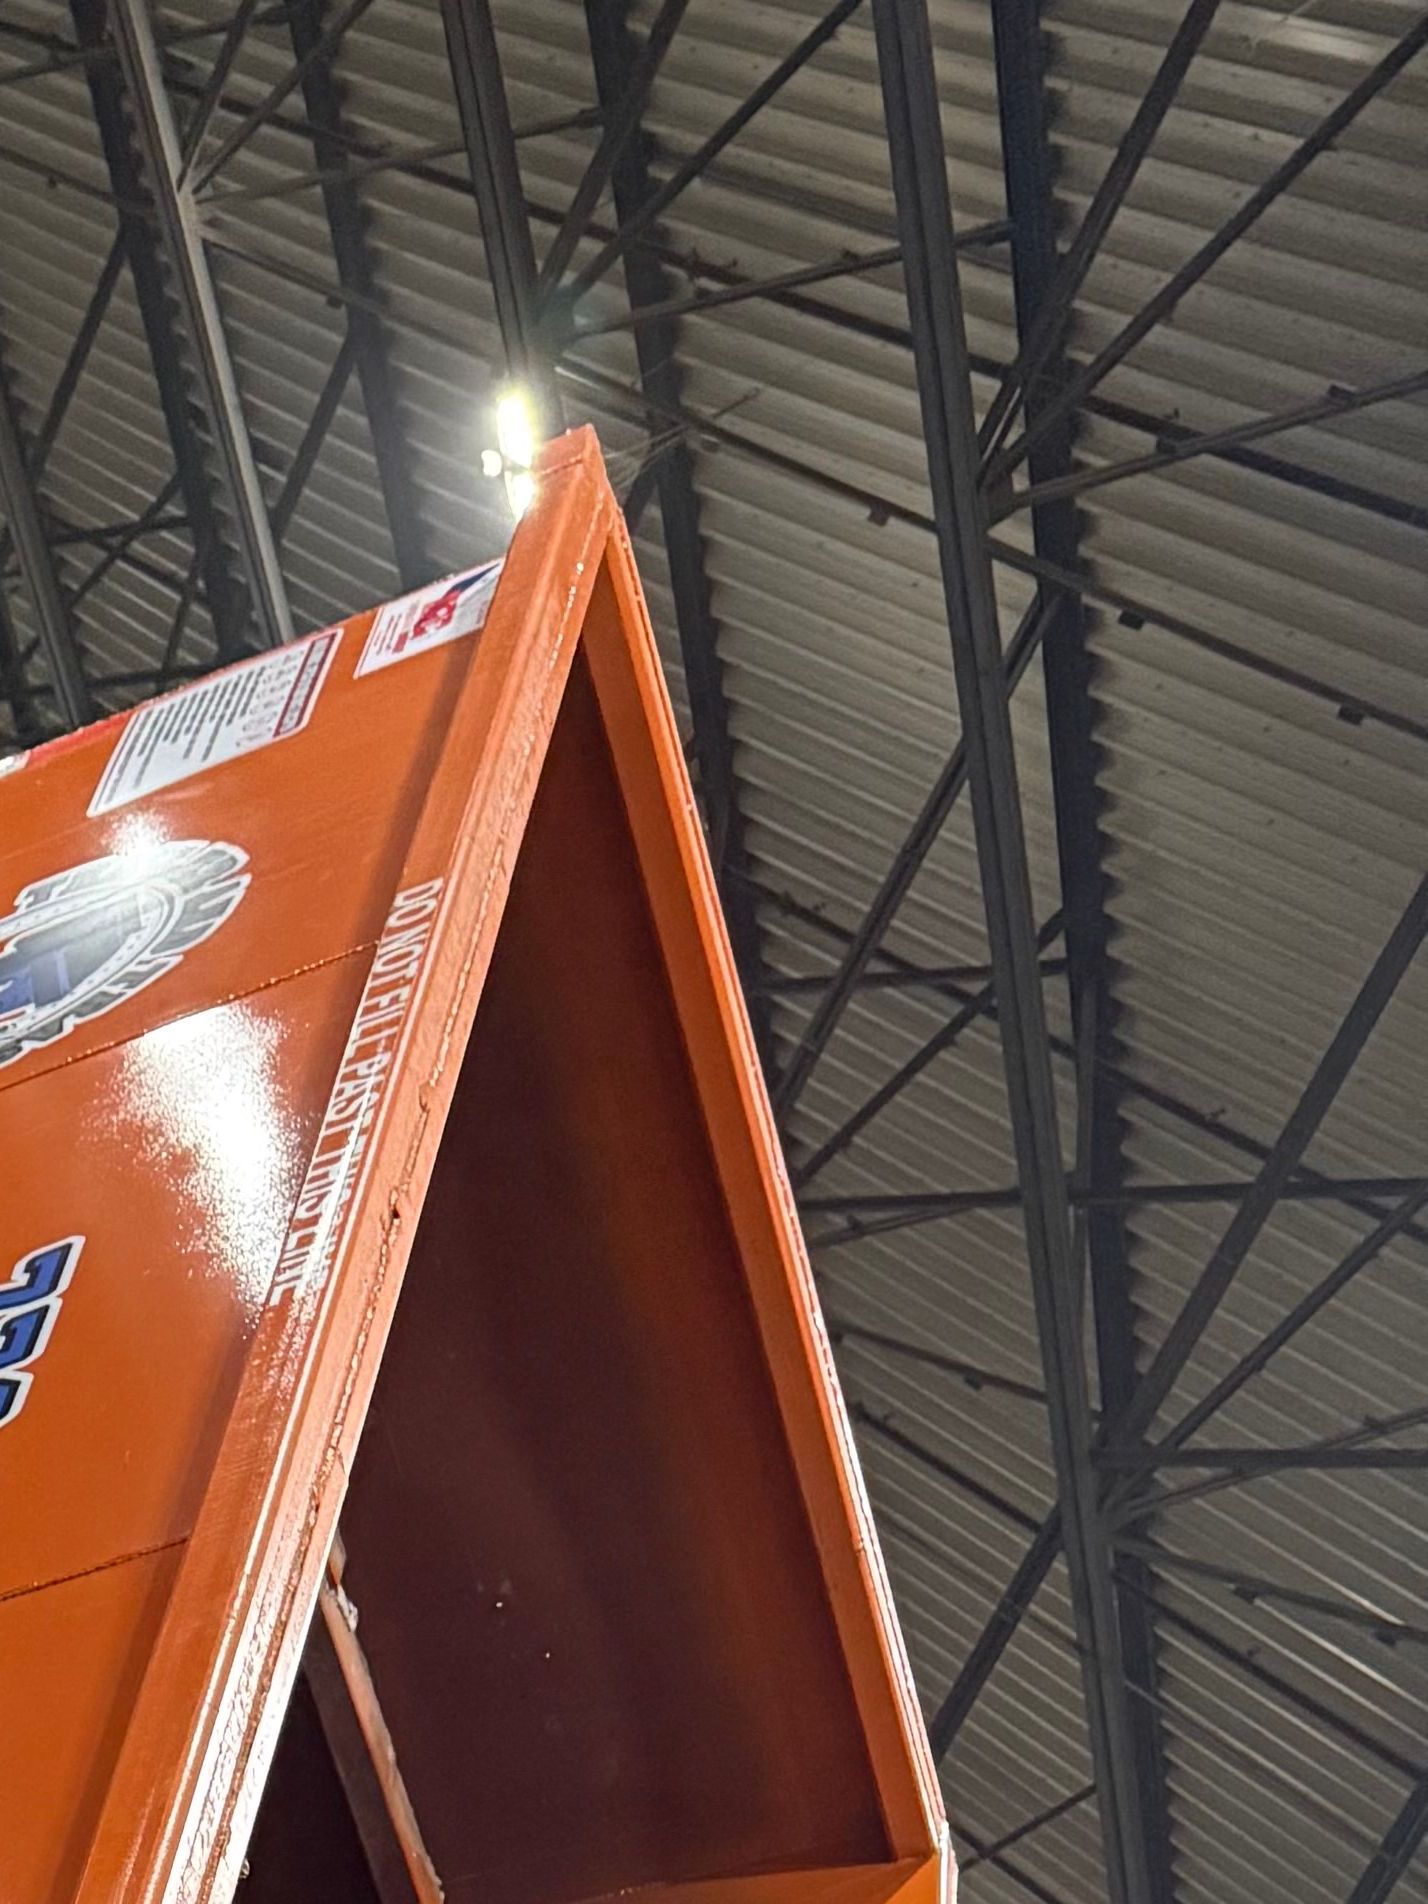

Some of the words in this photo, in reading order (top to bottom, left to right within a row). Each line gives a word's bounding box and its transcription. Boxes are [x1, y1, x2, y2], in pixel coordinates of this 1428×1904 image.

[387, 877, 444, 928] DO
[370, 922, 429, 986] NOT
[349, 984, 408, 1058] FILL
[325, 1050, 393, 1136] PAST
[293, 1130, 371, 1223] THIS
[269, 1212, 340, 1306] LINE
